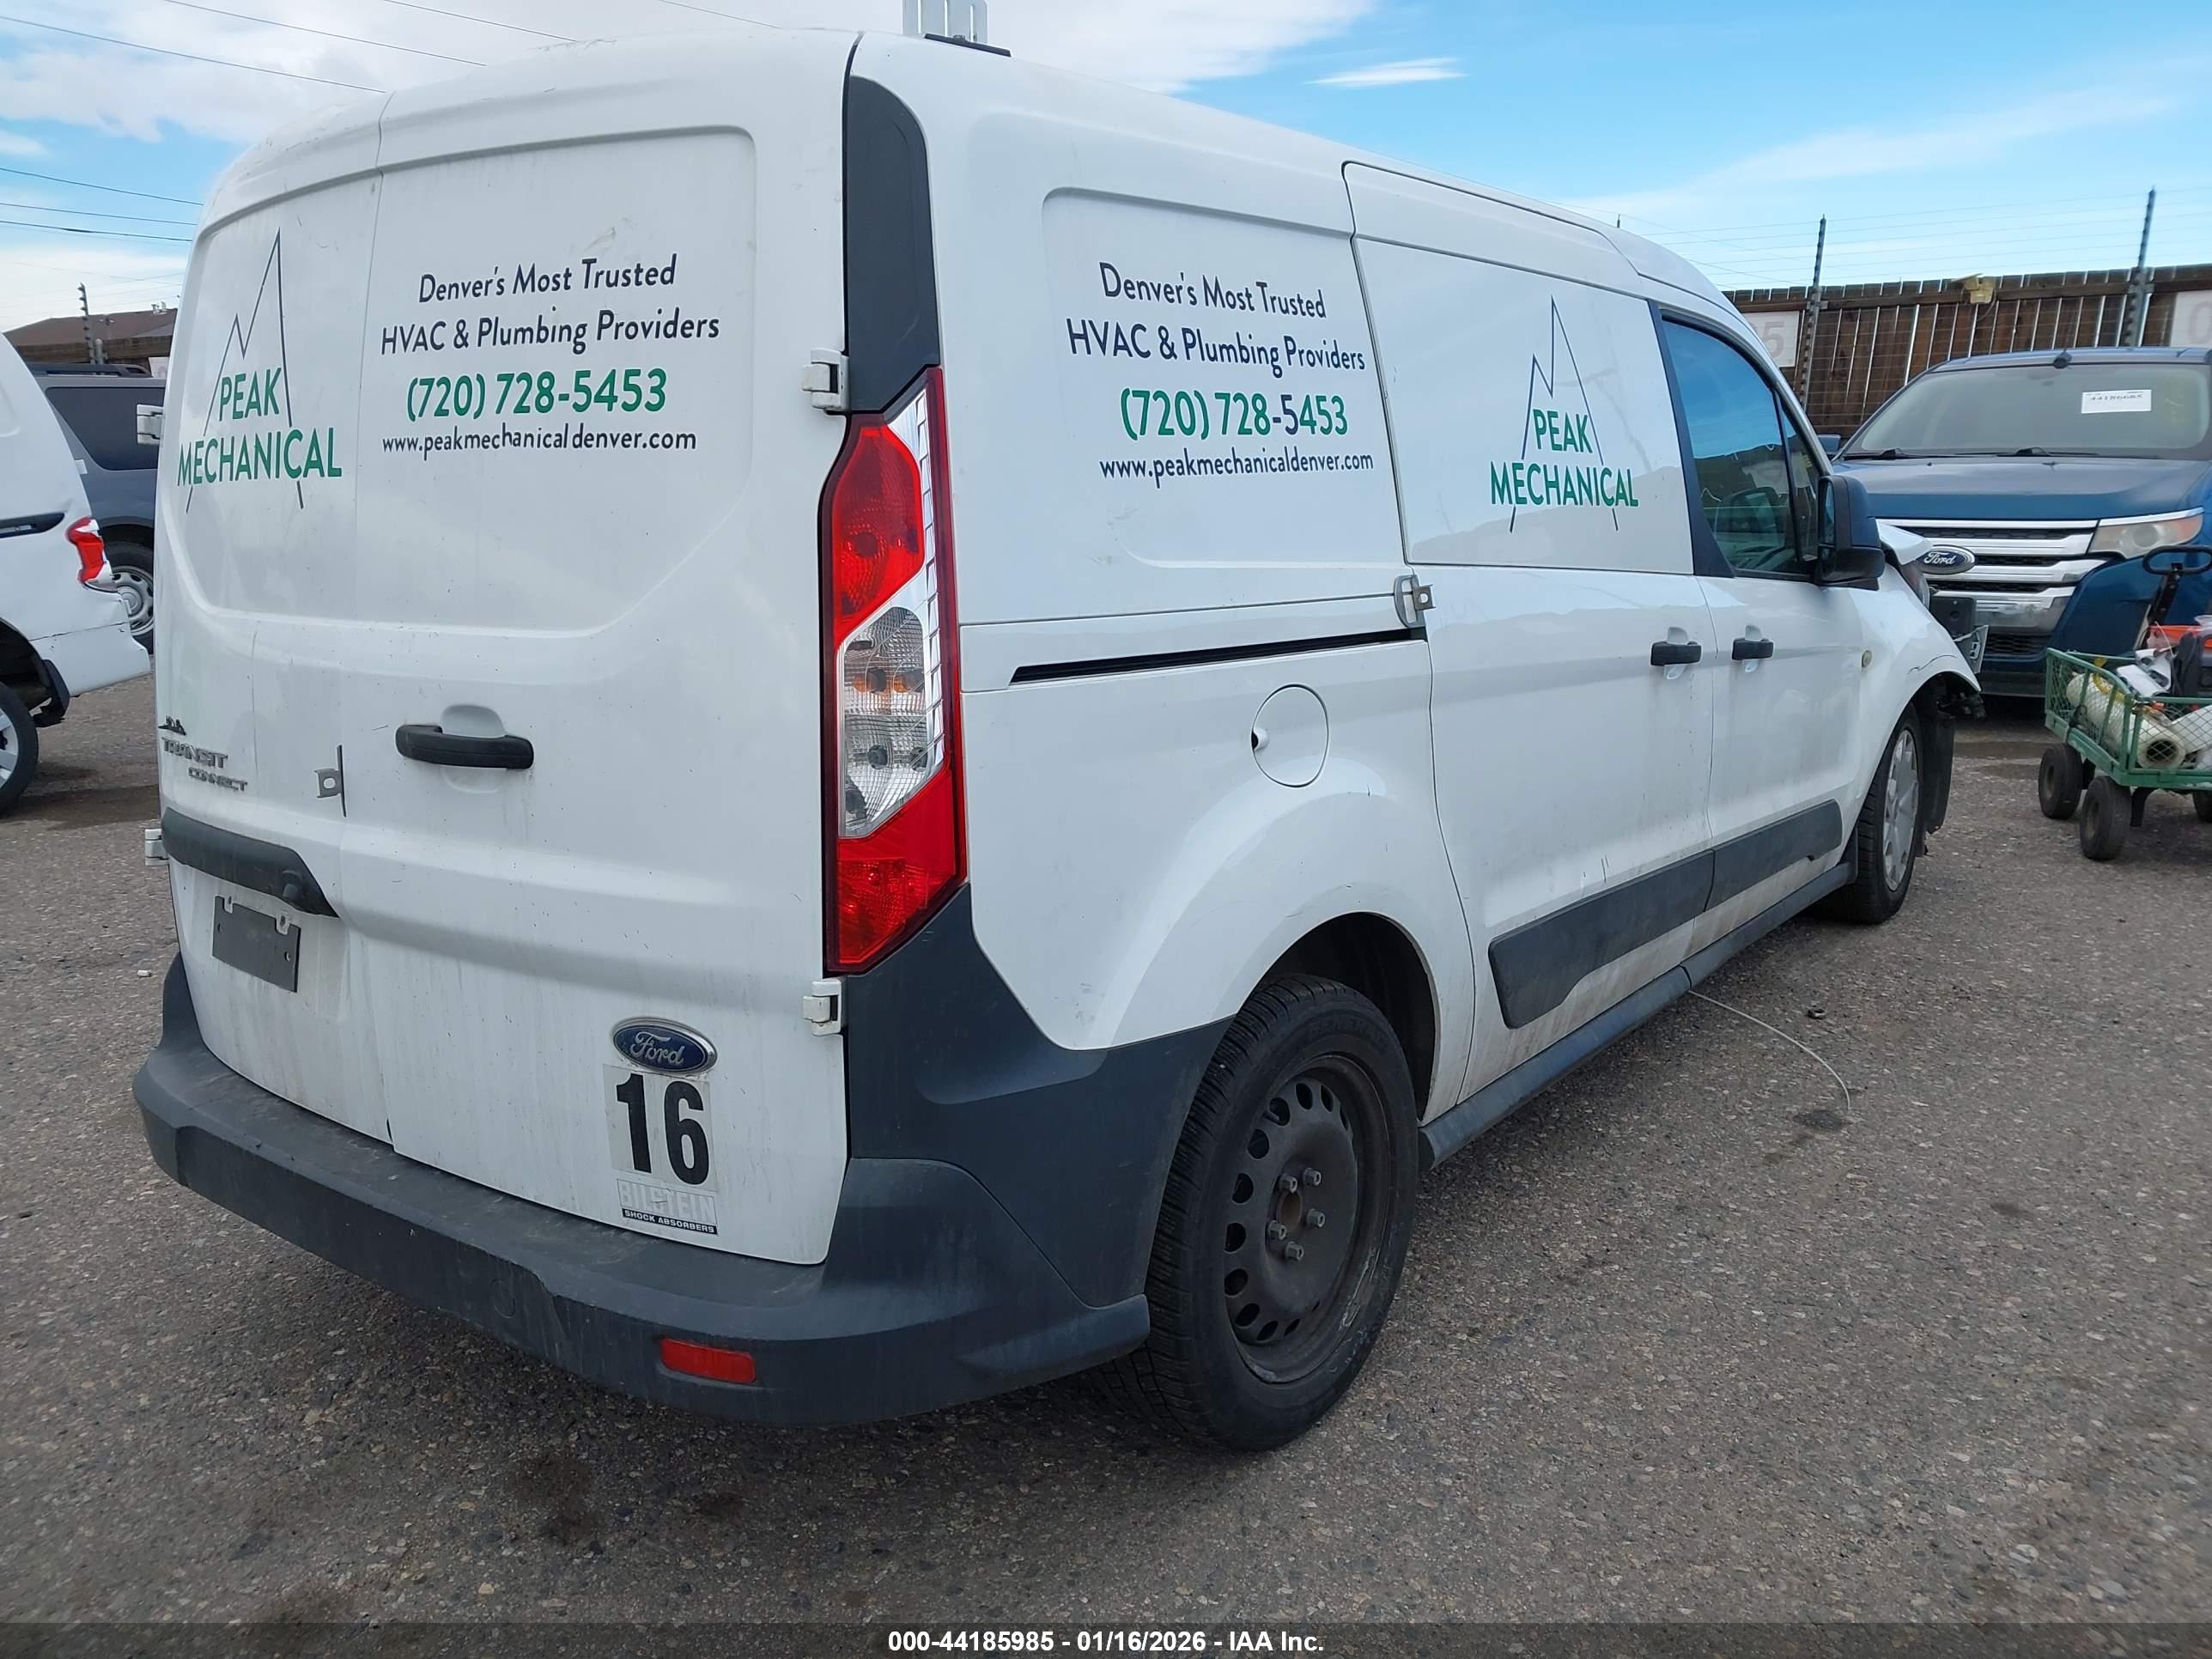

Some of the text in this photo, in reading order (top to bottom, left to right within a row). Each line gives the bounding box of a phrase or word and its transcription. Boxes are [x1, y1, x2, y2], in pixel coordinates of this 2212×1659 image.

[419, 253, 676, 303] Denver's Most Trusted
[1099, 262, 1327, 319] Denver's Most Trusted
[381, 307, 720, 355] HVAC & Plumbing Providers
[1066, 319, 1365, 379] HVAC & Plumbing Providers
[1753, 320, 1785, 358] 5
[218, 368, 282, 422] PEAK
[407, 368, 667, 422] (720) 728-5453
[1120, 387, 1348, 441] (720) 728-5453
[382, 423, 696, 461] www.peakmechanicaldenver.com
[1533, 409, 1592, 454] PEAK
[178, 428, 342, 487] MECHANICAL
[1099, 447, 1373, 489] www.peakmechanicaldenver.com
[1490, 460, 1638, 508] MECHANICAL
[1923, 551, 1957, 565] Ford
[161, 737, 228, 769] TRANSIT
[629, 1031, 685, 1066] Ford
[616, 1073, 709, 1186] 16
[624, 1209, 714, 1233] SHOCK ABSORBERS
